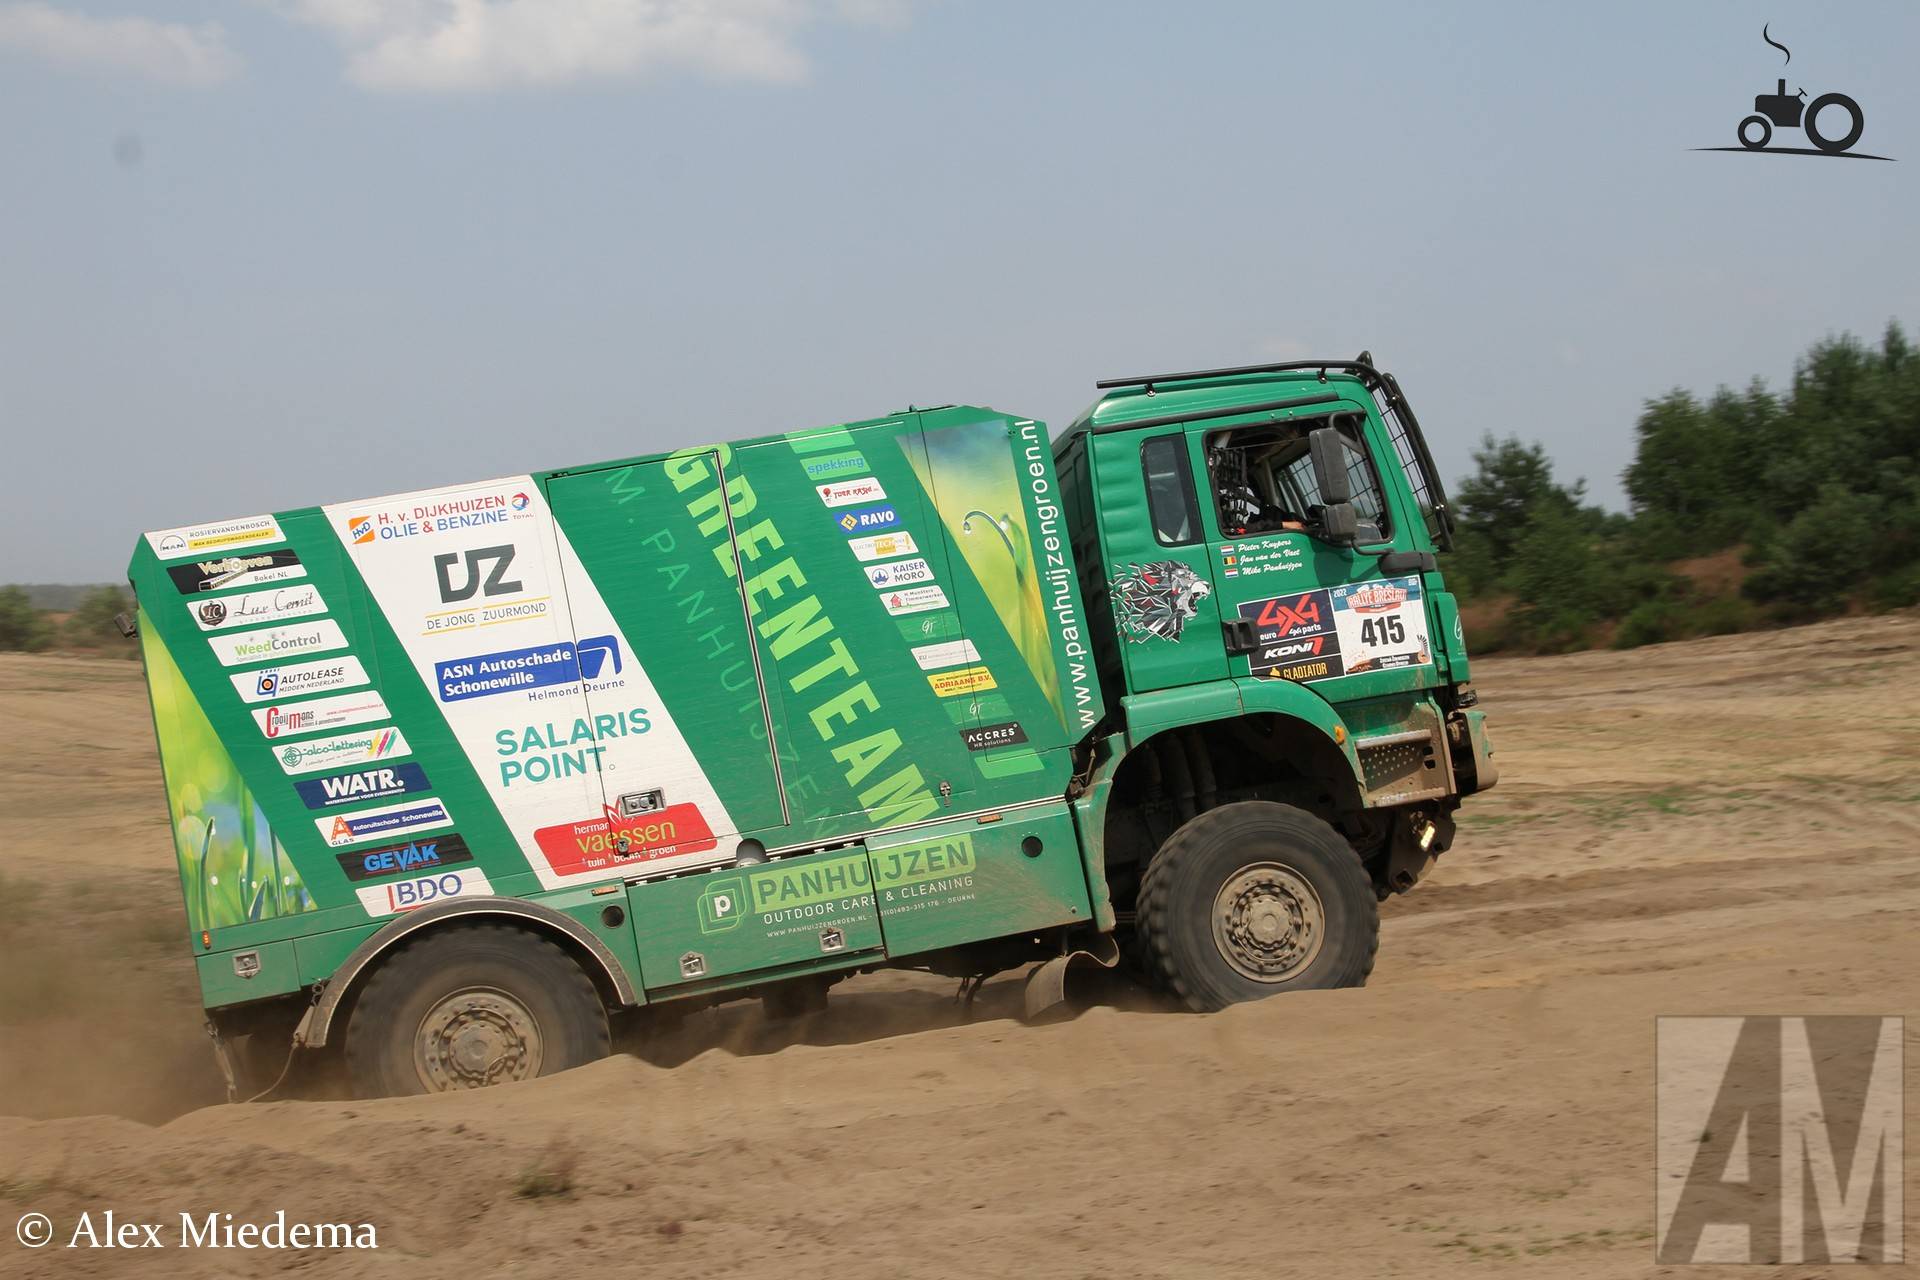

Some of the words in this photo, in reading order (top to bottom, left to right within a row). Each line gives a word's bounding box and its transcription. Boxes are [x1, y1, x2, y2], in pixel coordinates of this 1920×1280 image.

[807, 456, 865, 475] spekking
[378, 513, 393, 525] H.
[398, 513, 409, 522] v.
[413, 495, 506, 519] DIJKHUIZEN
[860, 510, 894, 526] RAVO
[380, 522, 419, 540] OLIE
[422, 521, 434, 533] &
[437, 509, 509, 531] BENZINE
[162, 543, 185, 552] MAN
[1240, 553, 1254, 566] Jan
[893, 561, 925, 573] KAISER
[894, 570, 925, 583] MORO
[1015, 419, 1093, 730] www.panhuijzengroen.nl
[427, 619, 442, 630] DE
[444, 613, 475, 628] JONG
[483, 602, 547, 621] ZUURMOND
[664, 441, 940, 829] GREENTEAM
[1260, 632, 1277, 641] euro
[1361, 614, 1405, 647] 415
[234, 632, 321, 656] WeedControl
[281, 667, 344, 685] AUTOLEASE
[443, 662, 474, 680] ASN
[479, 648, 572, 674] Autoschade
[1283, 662, 1328, 679] GLADIATOR
[279, 684, 305, 693] MIDDEN
[307, 678, 344, 690] NEDERLAND
[444, 672, 535, 697] Schonewille
[528, 684, 579, 702] Helmond
[583, 678, 625, 693] Deurne
[495, 708, 652, 756] SALARIS
[968, 727, 1015, 743] ACCRES
[500, 746, 607, 787] POINT
[321, 769, 404, 798] WATR.
[576, 821, 676, 854] vaessen
[364, 842, 439, 871] GEVAK
[588, 857, 606, 868] tuin
[649, 845, 676, 859] groen
[757, 840, 969, 905] PANHUIJZEN
[396, 874, 462, 905] BDO
[763, 902, 834, 925] OUTDOOR
[842, 894, 877, 911] CARE
[885, 891, 895, 902] &
[901, 876, 973, 899] CLEANING
